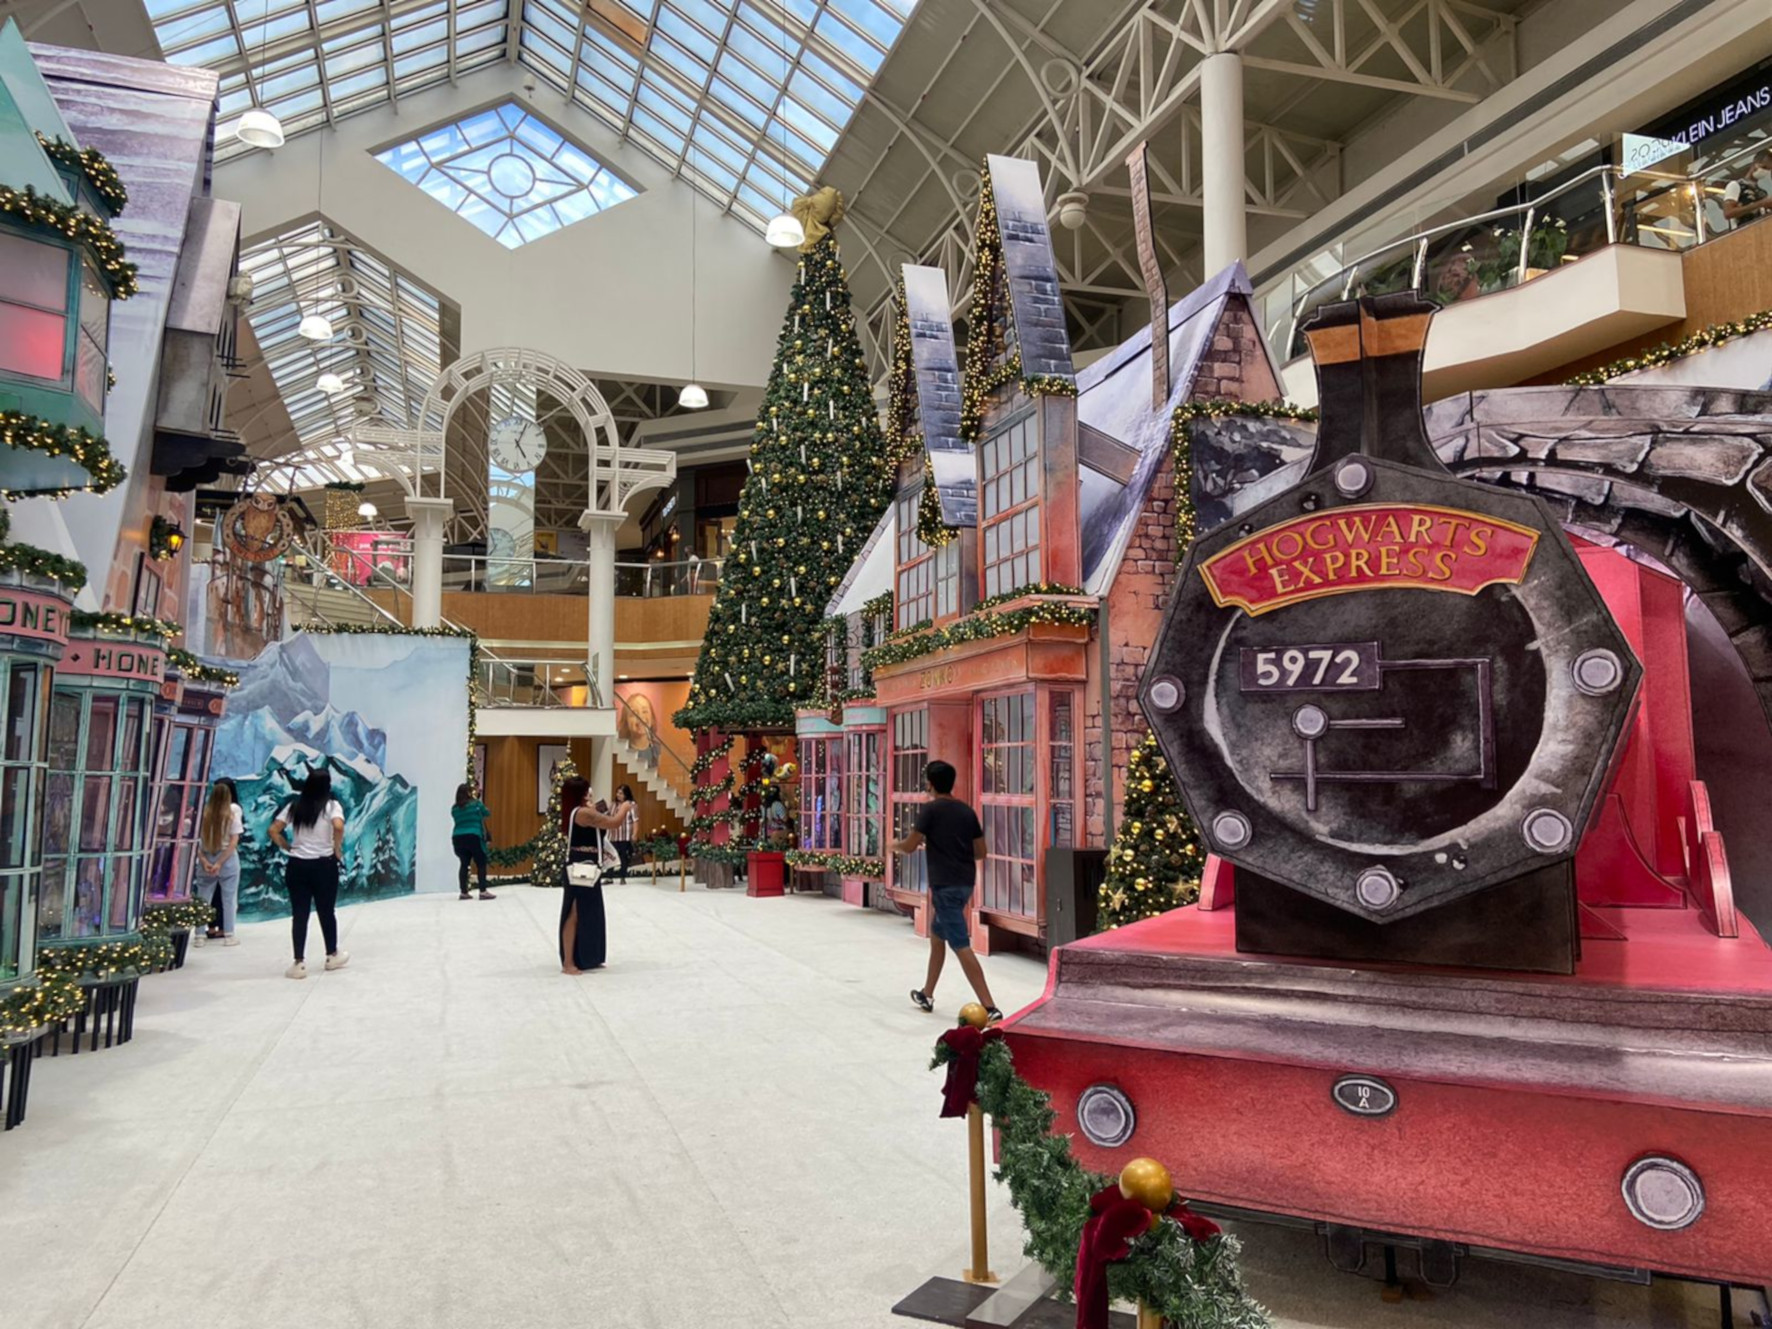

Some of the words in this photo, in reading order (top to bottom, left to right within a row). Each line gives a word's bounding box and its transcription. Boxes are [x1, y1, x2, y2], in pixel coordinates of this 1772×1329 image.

[1671, 115, 1715, 146] KLEIN
[1716, 86, 1771, 129] JEANS
[1242, 514, 1494, 577] HOGWARTS
[1268, 545, 1457, 595] EXPRESS
[1256, 649, 1360, 687] 5972
[1357, 1086, 1371, 1098] 10
[1358, 1097, 1370, 1109] A
